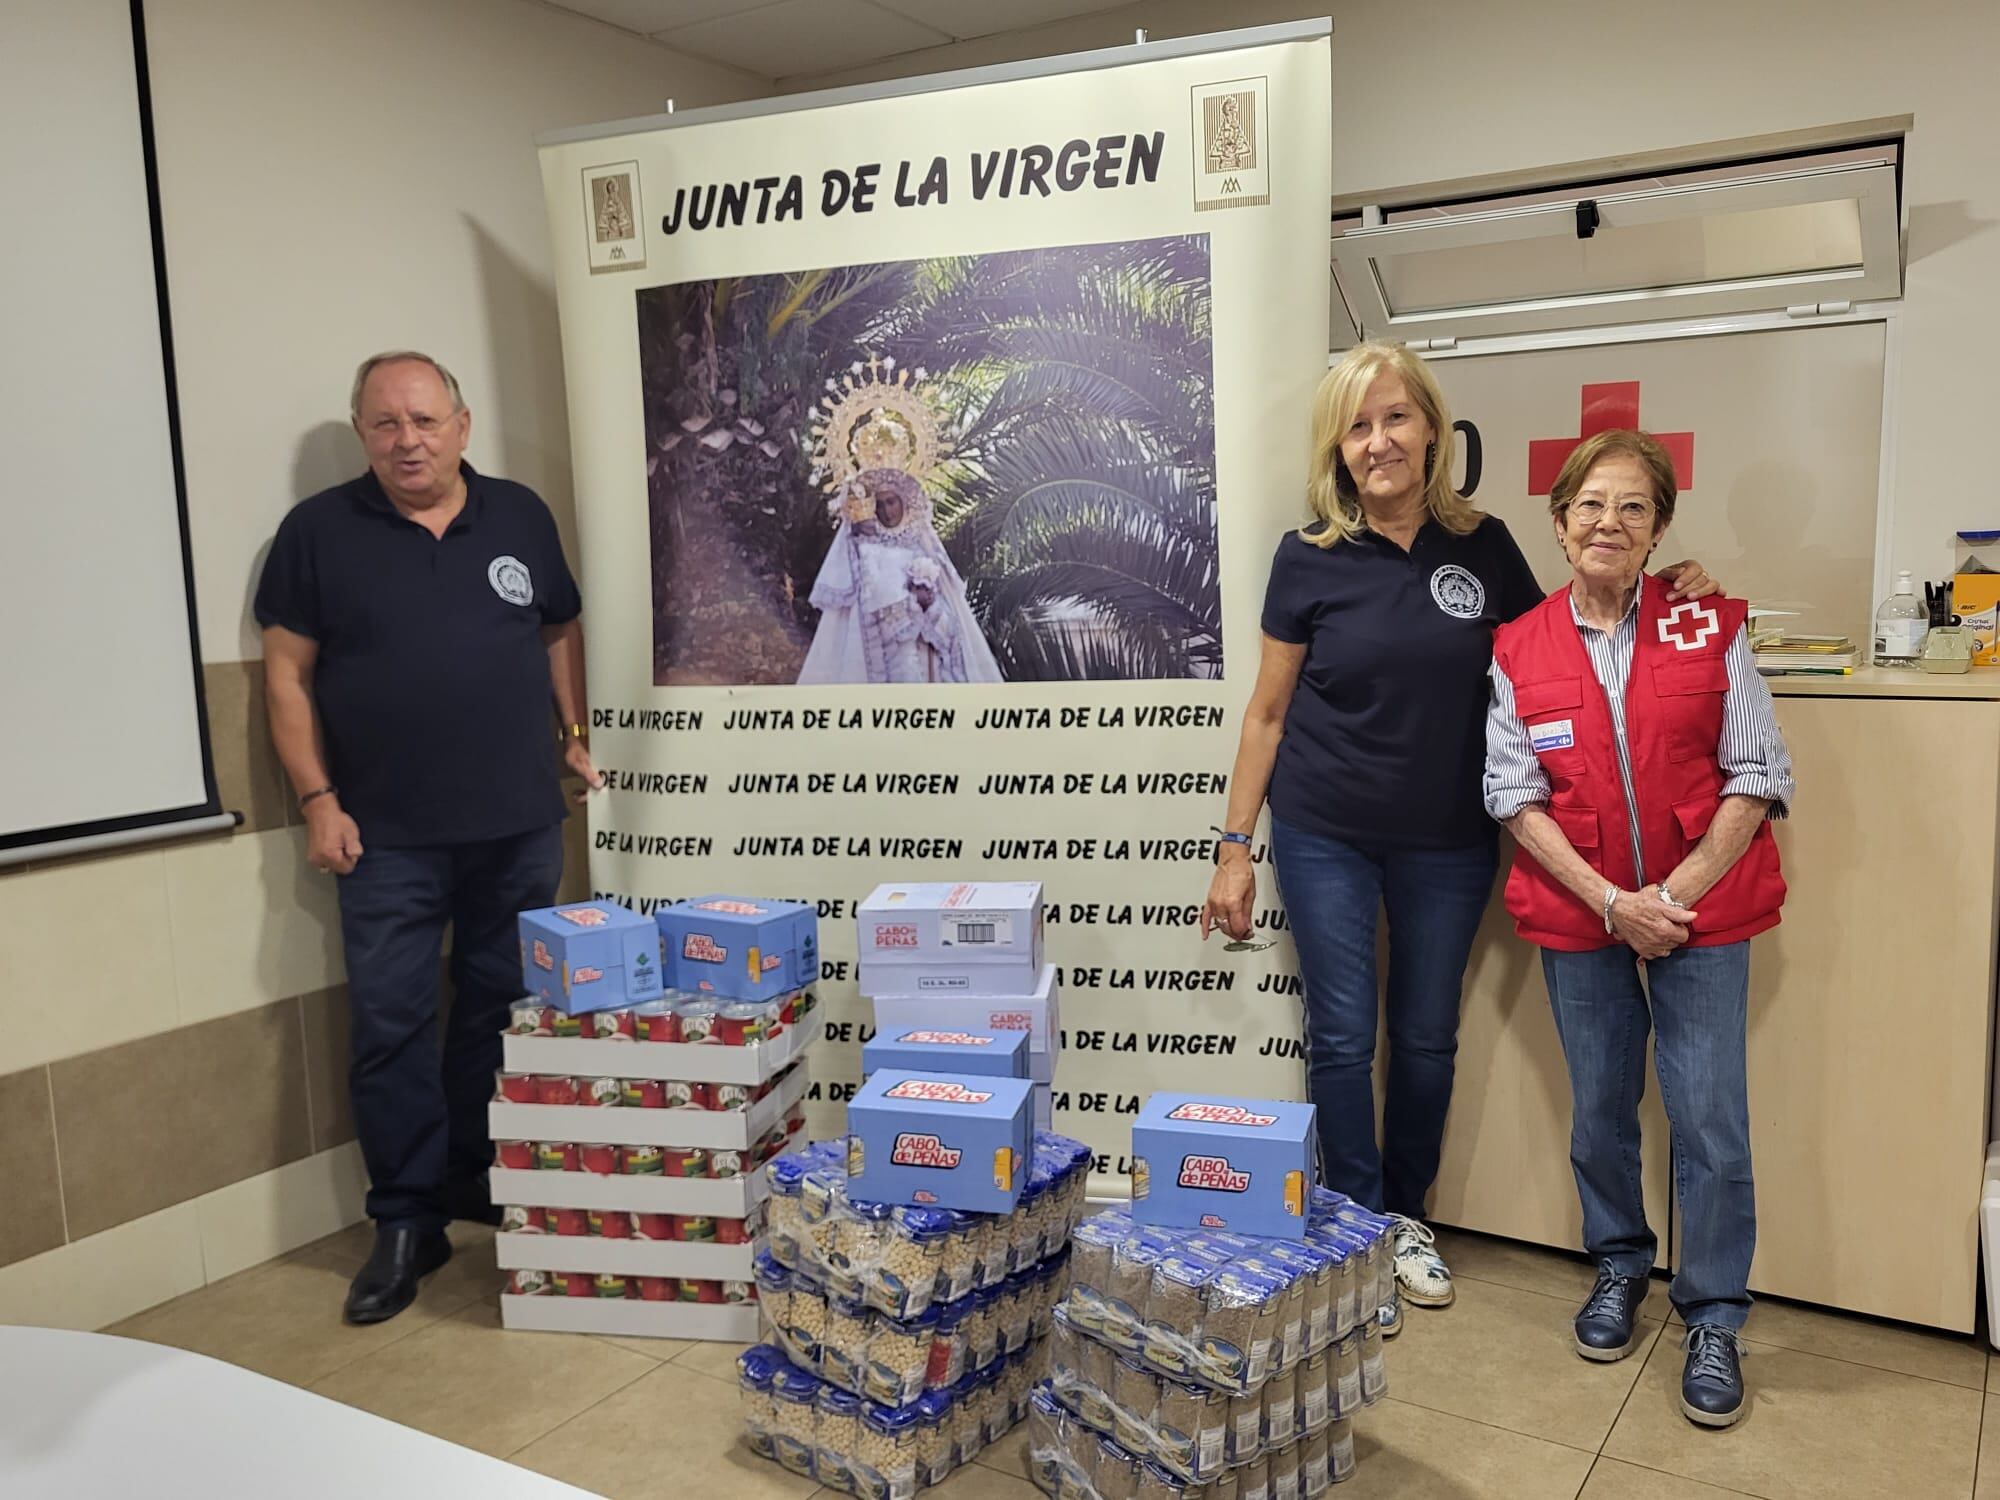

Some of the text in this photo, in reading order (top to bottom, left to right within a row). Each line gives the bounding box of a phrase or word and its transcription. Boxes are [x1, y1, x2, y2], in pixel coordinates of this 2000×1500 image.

[662, 132, 1164, 235] JUNTA DE LA VIRGEN
[592, 705, 1224, 731] DE LA VIRGEN JUNTA DE LA VIRGEN JUNTA DE LA VIRGEN
[620, 771, 635, 791] LA
[638, 772, 708, 795] VIRGEN
[728, 774, 799, 794] JUNTA
[807, 773, 836, 793] DE
[842, 773, 867, 793] LA
[876, 773, 959, 795] VIRGEN
[978, 774, 1054, 795] JUNTA
[1063, 773, 1094, 794] DE
[1100, 774, 1127, 794] LA
[1137, 772, 1228, 795] VIRGEN
[595, 830, 617, 851] DE
[619, 833, 633, 854] LA
[638, 835, 713, 857] VIRGEN
[733, 837, 804, 856] JUNTA
[812, 836, 841, 857] DE
[847, 837, 871, 857] LA
[879, 837, 963, 860] VIRGEN
[982, 839, 1057, 860] JUNTA
[1066, 839, 1097, 860] DE
[1103, 839, 1129, 860] LA
[815, 899, 845, 919] DE
[1069, 903, 1100, 924] DE
[1106, 904, 1132, 925] LA
[1142, 905, 1206, 927] VIRG
[1254, 909, 1290, 931] JU
[875, 935, 919, 946] PEÑAS
[876, 925, 910, 936] CABO
[821, 961, 849, 981] DE
[1072, 967, 1103, 988] DE
[1109, 968, 1135, 989] LA
[1144, 970, 1235, 992] VIRGEN
[1257, 973, 1304, 996] JUN
[824, 1021, 853, 1043] DE
[1075, 1030, 1106, 1051] DE
[1111, 1032, 1137, 1053] LA
[1147, 1033, 1237, 1056] VIRGEN
[1259, 1037, 1305, 1059] JUN
[828, 1081, 857, 1103] DE
[1078, 1092, 1109, 1113] DE
[1114, 1094, 1140, 1115] LA
[898, 1135, 939, 1150] CABO
[895, 1147, 960, 1166] de PEÑAS
[1185, 1157, 1225, 1173] CABO
[1181, 1171, 1248, 1190] de PEÑAS
